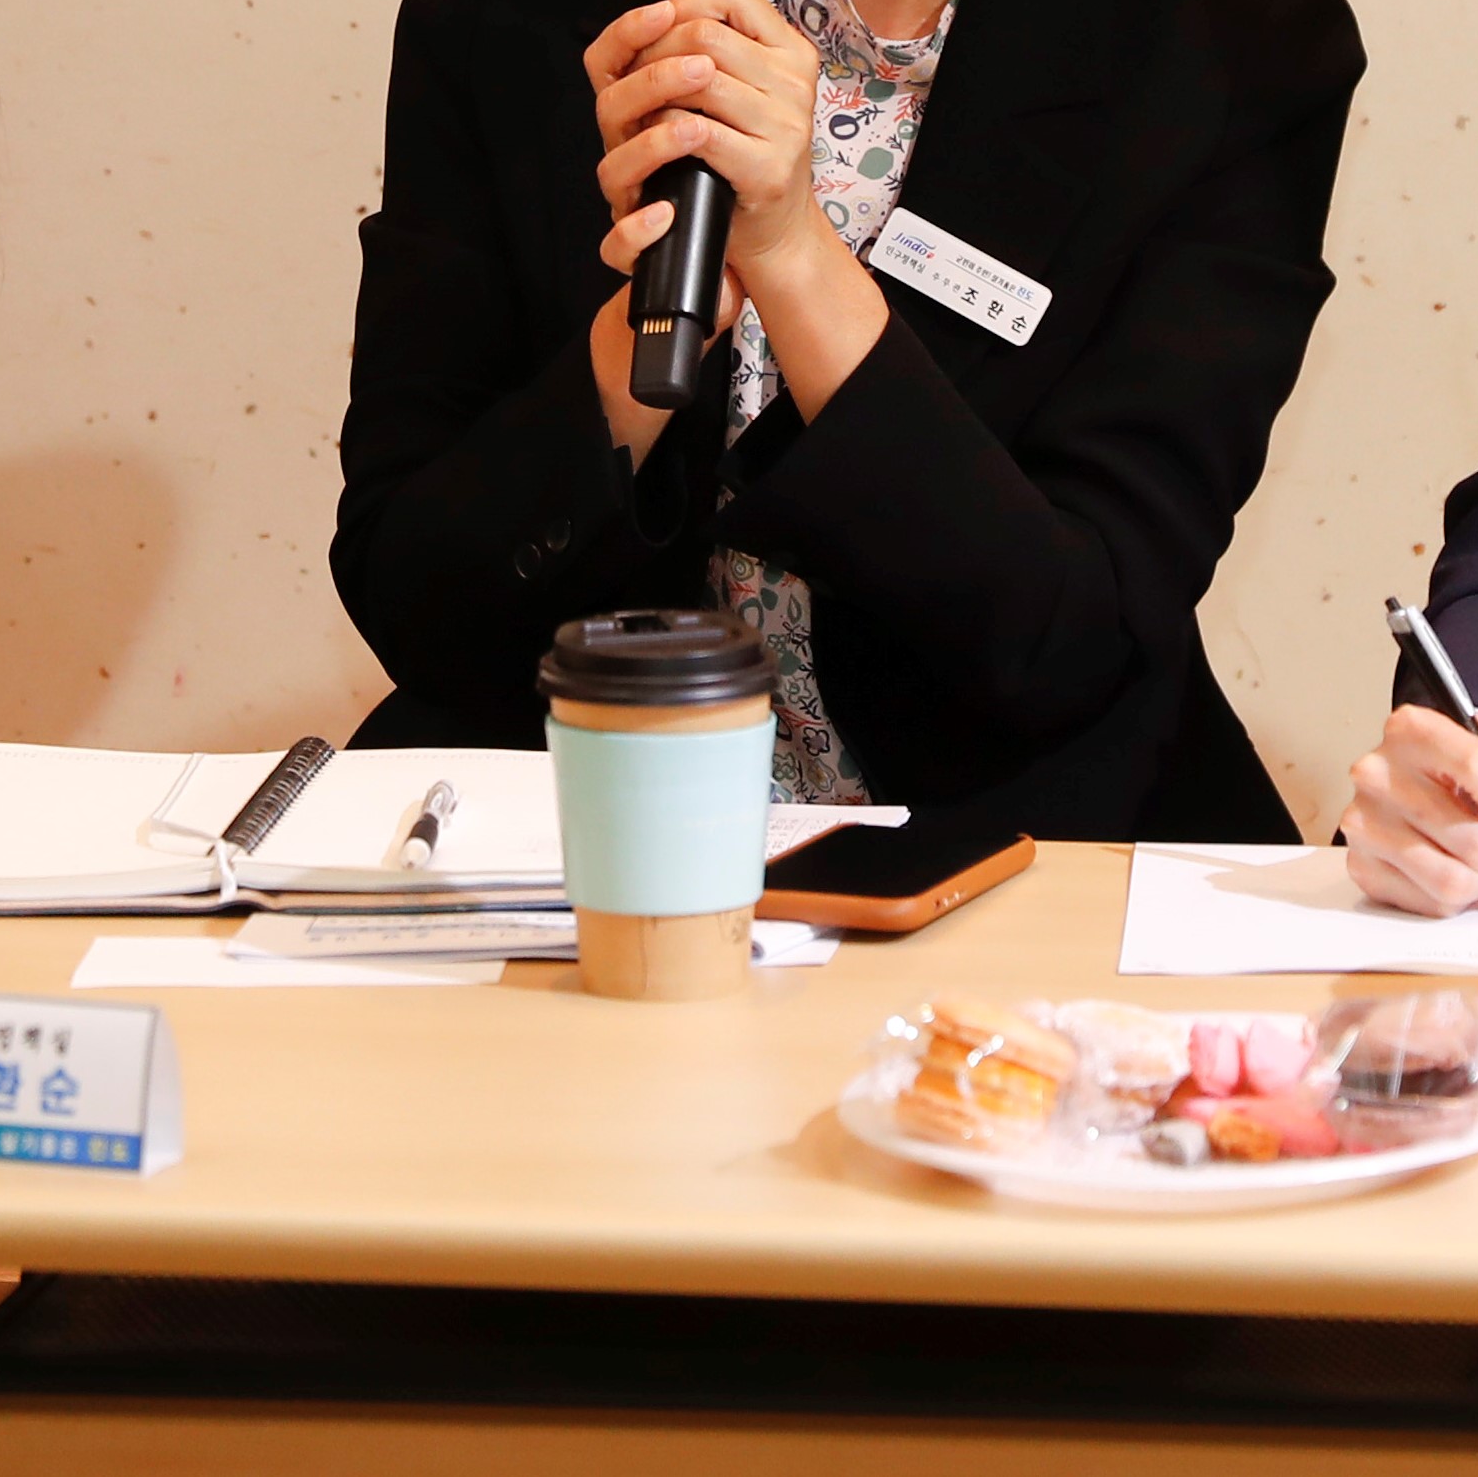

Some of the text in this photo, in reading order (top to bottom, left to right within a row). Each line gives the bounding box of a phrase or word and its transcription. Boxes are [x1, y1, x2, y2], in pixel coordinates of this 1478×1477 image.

[891, 232, 928, 257] Jindo
[885, 245, 926, 274] 인구정책실
[961, 287, 1028, 334] 조환순
[1016, 285, 1035, 301] 진도
